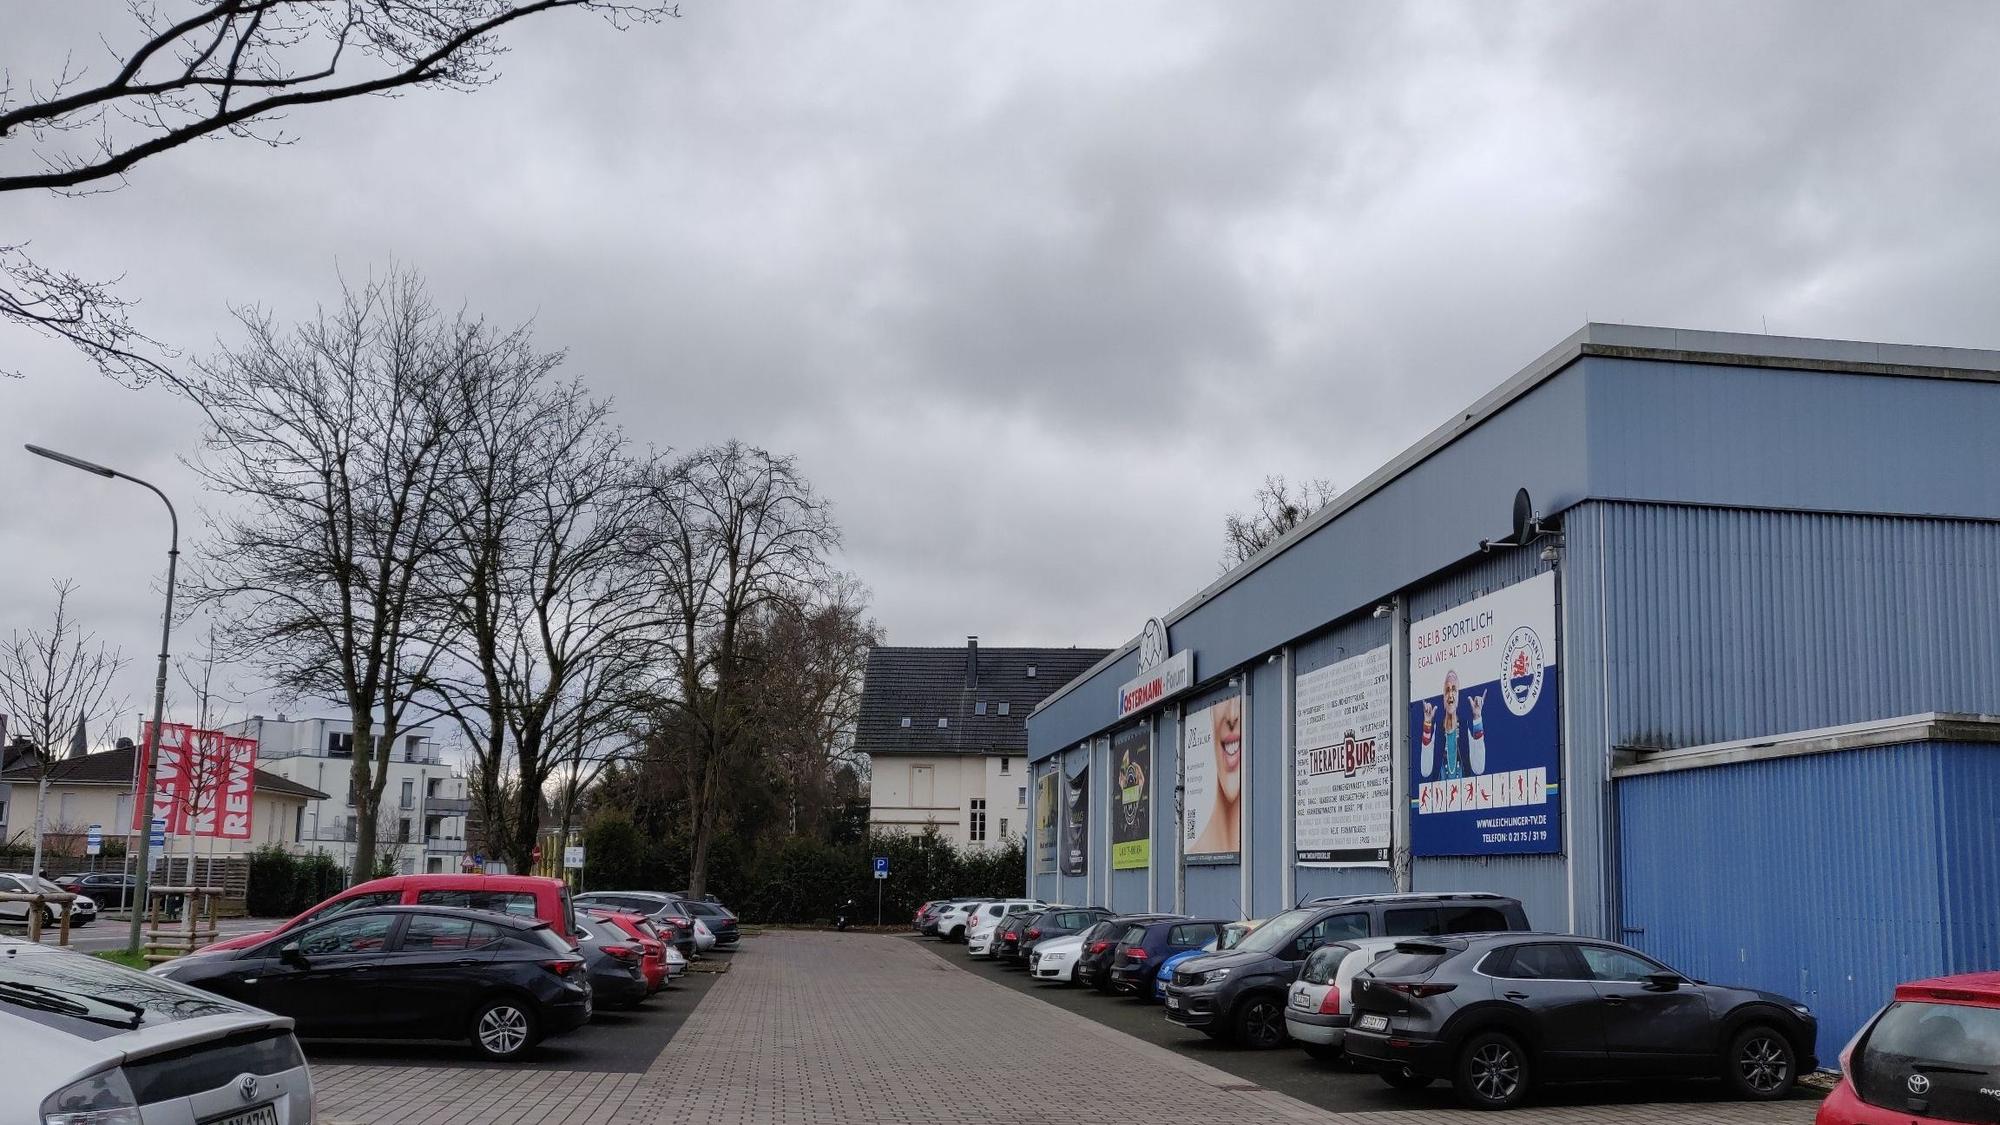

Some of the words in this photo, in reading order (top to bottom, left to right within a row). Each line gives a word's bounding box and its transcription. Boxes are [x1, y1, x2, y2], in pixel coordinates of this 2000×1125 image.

[1418, 630, 1440, 650] BLEIB
[1442, 610, 1493, 642] SPORTLICH
[1418, 654, 1433, 668] EGAL
[1435, 649, 1447, 664] WIE
[1449, 645, 1461, 659] ALT
[1463, 642, 1473, 654] DU
[1476, 634, 1493, 650] BIST!
[1124, 677, 1163, 713] OSTERMANN
[186, 734, 218, 832] REWE
[223, 743, 253, 835] REWE
[1477, 815, 1546, 828] WWW.LEICHLINGER-TV.DE
[1483, 834, 1507, 842] TELEFON:
[877, 859, 885, 870] P
